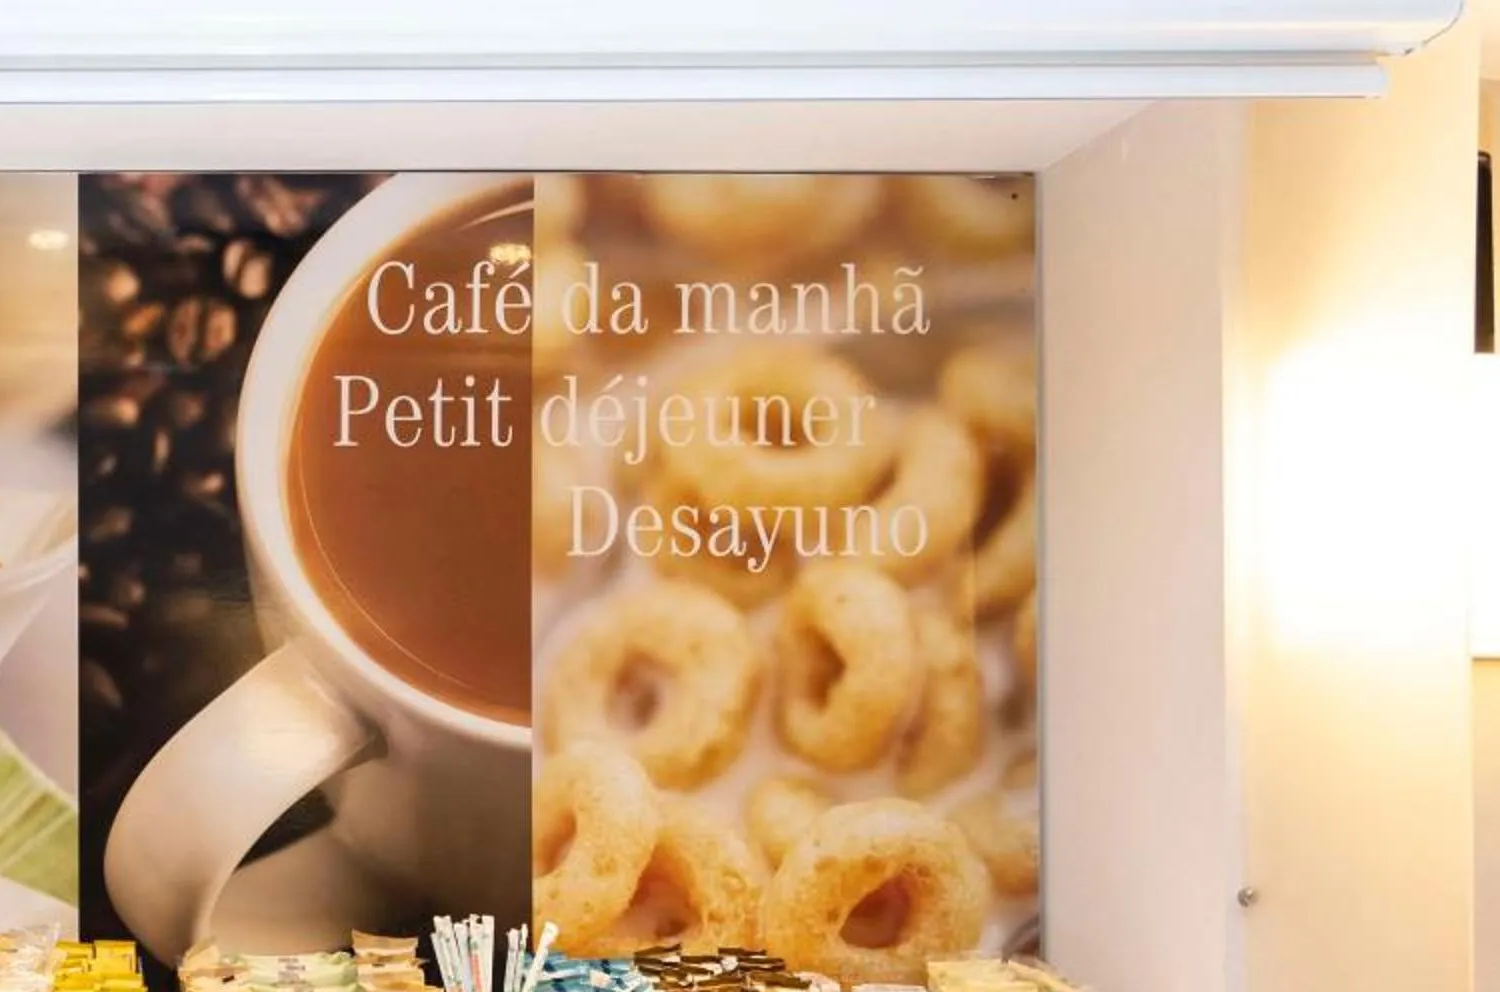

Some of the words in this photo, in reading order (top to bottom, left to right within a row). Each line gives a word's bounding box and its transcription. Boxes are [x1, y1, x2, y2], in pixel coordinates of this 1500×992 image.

[366, 261, 532, 335] Café
[562, 262, 649, 335] da
[674, 262, 931, 335] manhã
[332, 374, 513, 447] Petit
[540, 373, 877, 465] déjeuner
[566, 485, 929, 573] Desayuno
